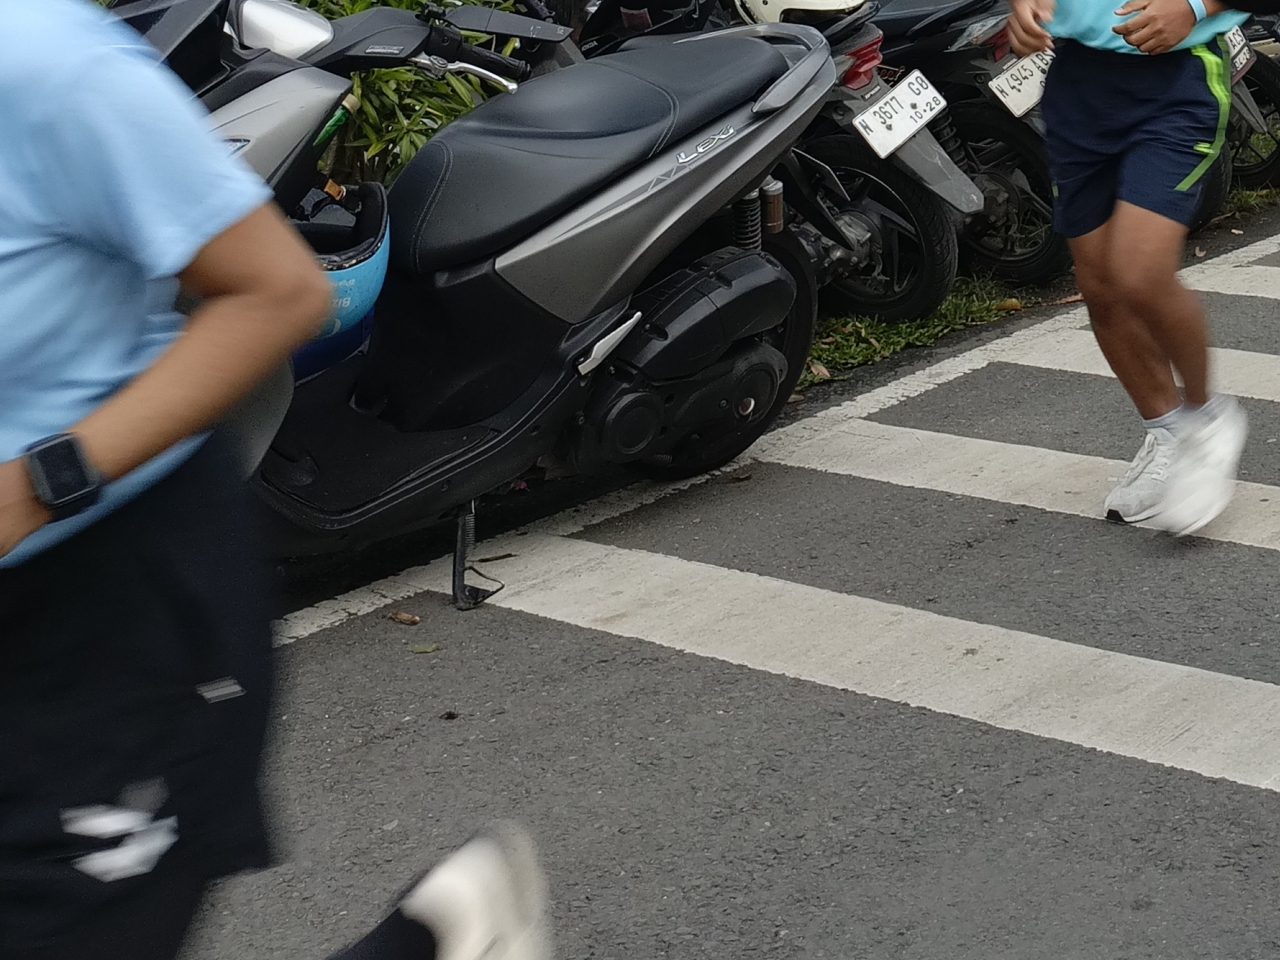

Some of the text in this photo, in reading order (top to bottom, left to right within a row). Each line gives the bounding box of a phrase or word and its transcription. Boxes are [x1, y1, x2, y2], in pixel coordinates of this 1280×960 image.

[995, 84, 1009, 99] N
[1005, 65, 1034, 91] 4945
[858, 119, 874, 136] N
[873, 96, 904, 125] 3677
